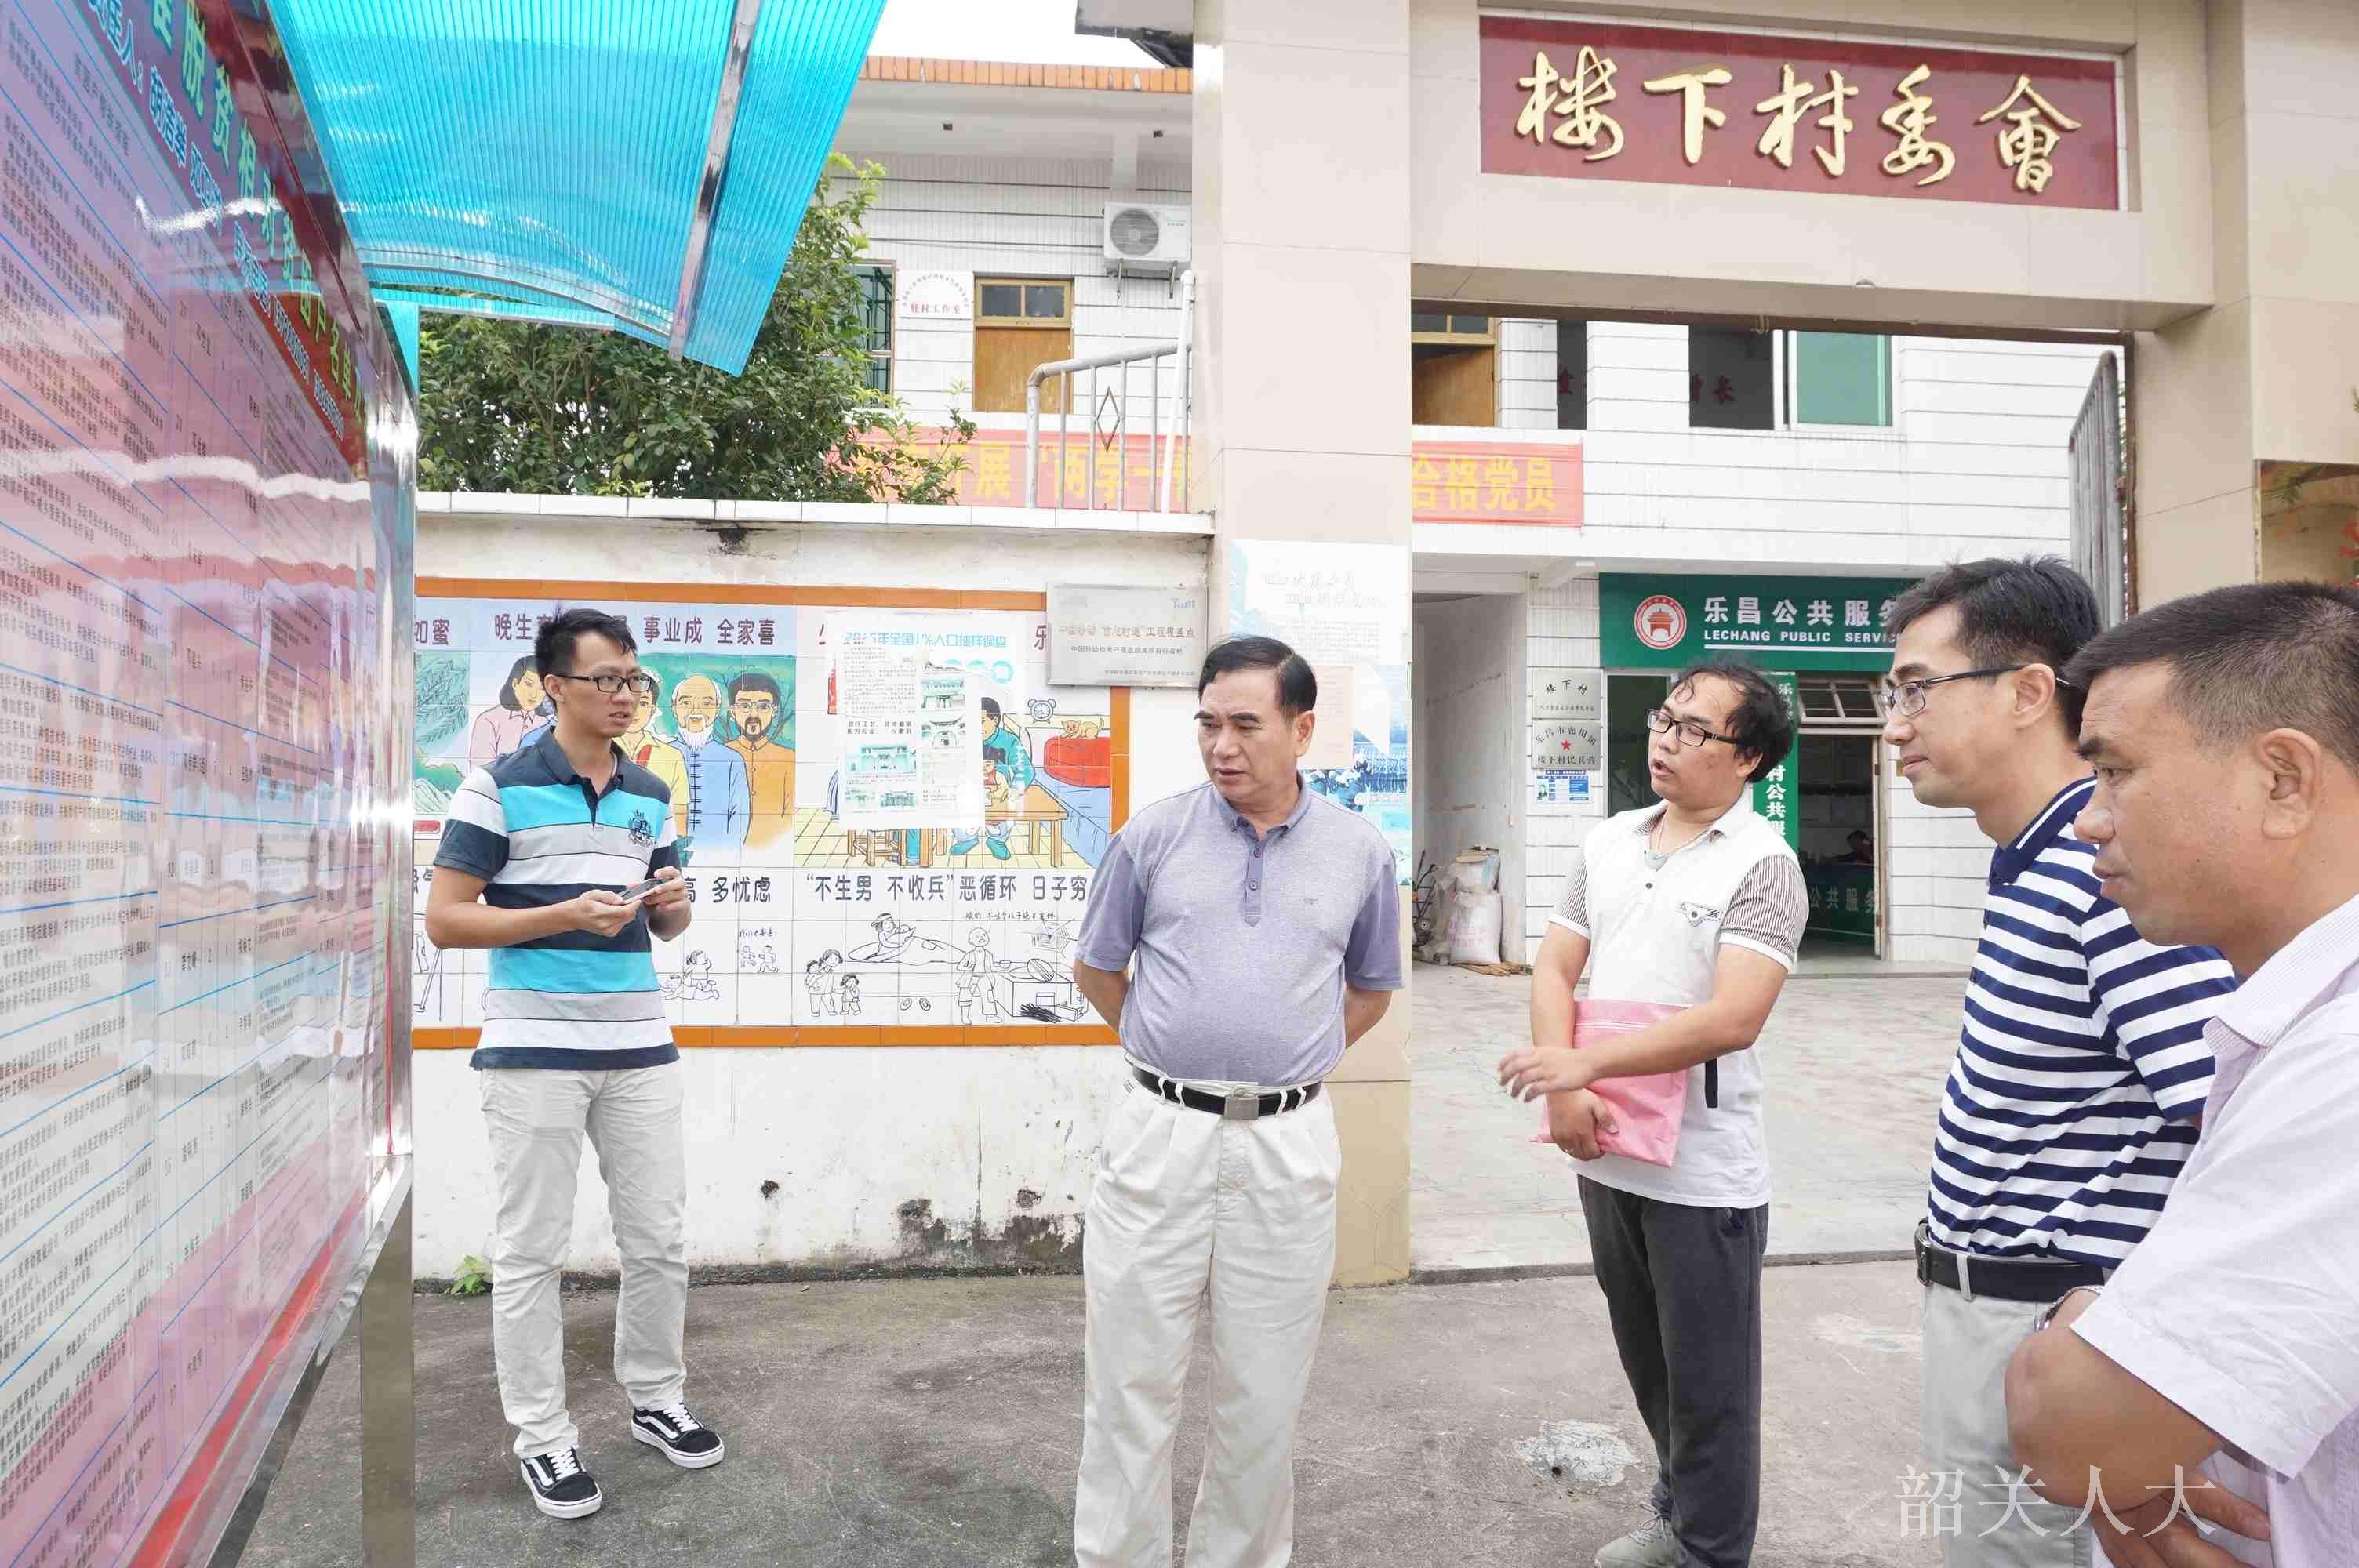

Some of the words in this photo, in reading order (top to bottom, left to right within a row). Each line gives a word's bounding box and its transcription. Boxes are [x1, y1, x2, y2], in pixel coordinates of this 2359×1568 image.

[643, 615, 703, 644] 事业成
[717, 618, 776, 646] 全家喜
[1704, 630, 1771, 641] LECHANG
[1780, 631, 1831, 642] PUBLIC
[712, 876, 772, 905] 多忧虑
[959, 873, 1017, 902] 恶循环
[1032, 874, 1088, 902] 日子穷
